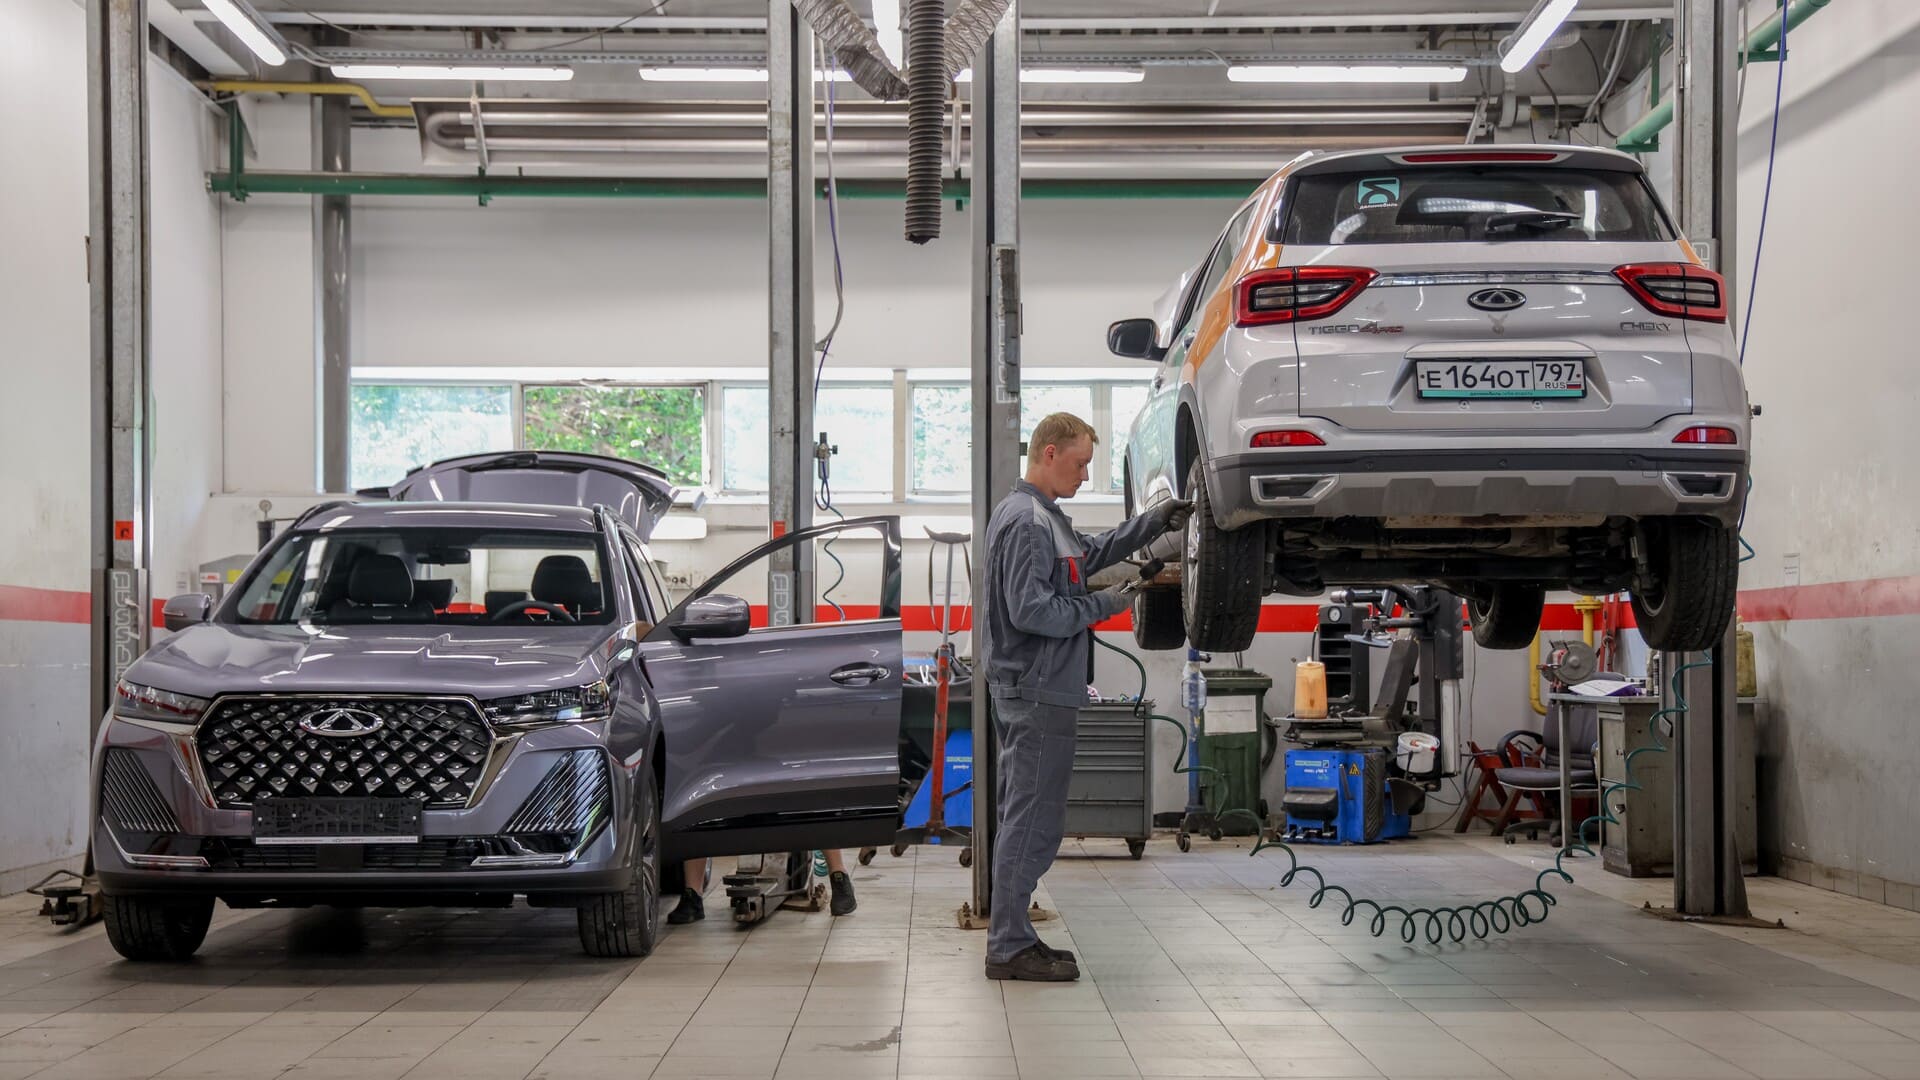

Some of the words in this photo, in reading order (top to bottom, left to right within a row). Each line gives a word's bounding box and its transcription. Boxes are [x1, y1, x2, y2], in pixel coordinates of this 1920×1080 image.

[1308, 324, 1360, 335] TIGGO
[1619, 321, 1671, 332] CHERY
[1535, 363, 1576, 382] 797
[1544, 381, 1566, 390] RUS
